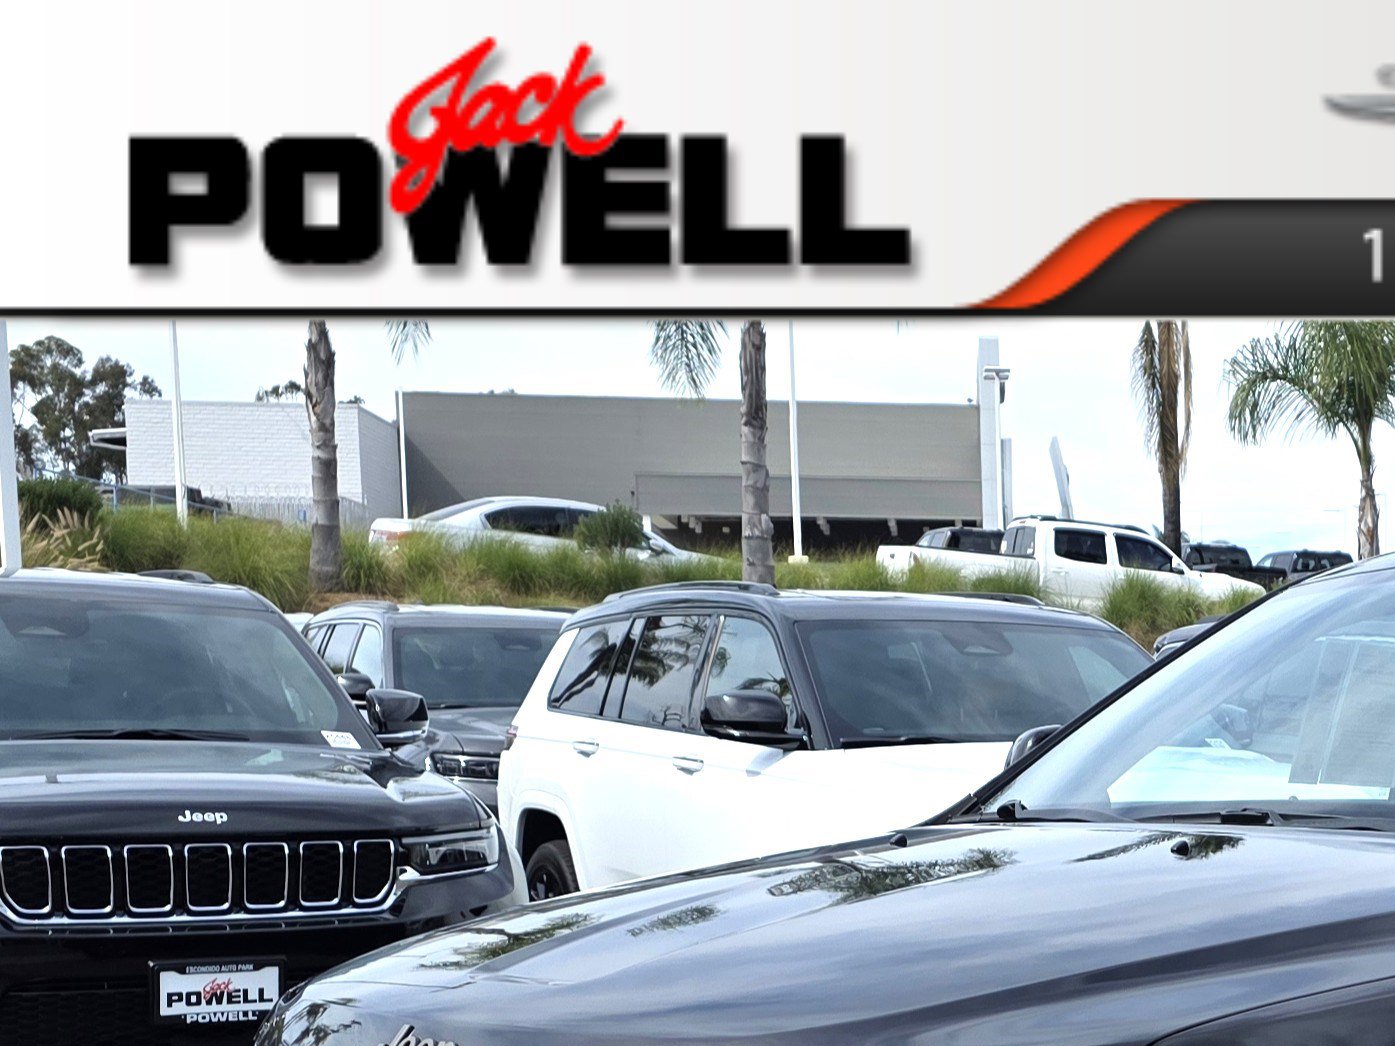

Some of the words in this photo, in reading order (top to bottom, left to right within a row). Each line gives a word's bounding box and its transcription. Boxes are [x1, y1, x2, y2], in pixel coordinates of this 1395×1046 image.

[178, 810, 228, 824] Jeep
[221, 964, 236, 972] AUTO
[238, 963, 254, 971] PARK
[166, 987, 274, 1008] POWELL
[186, 1010, 258, 1024] POWELL
